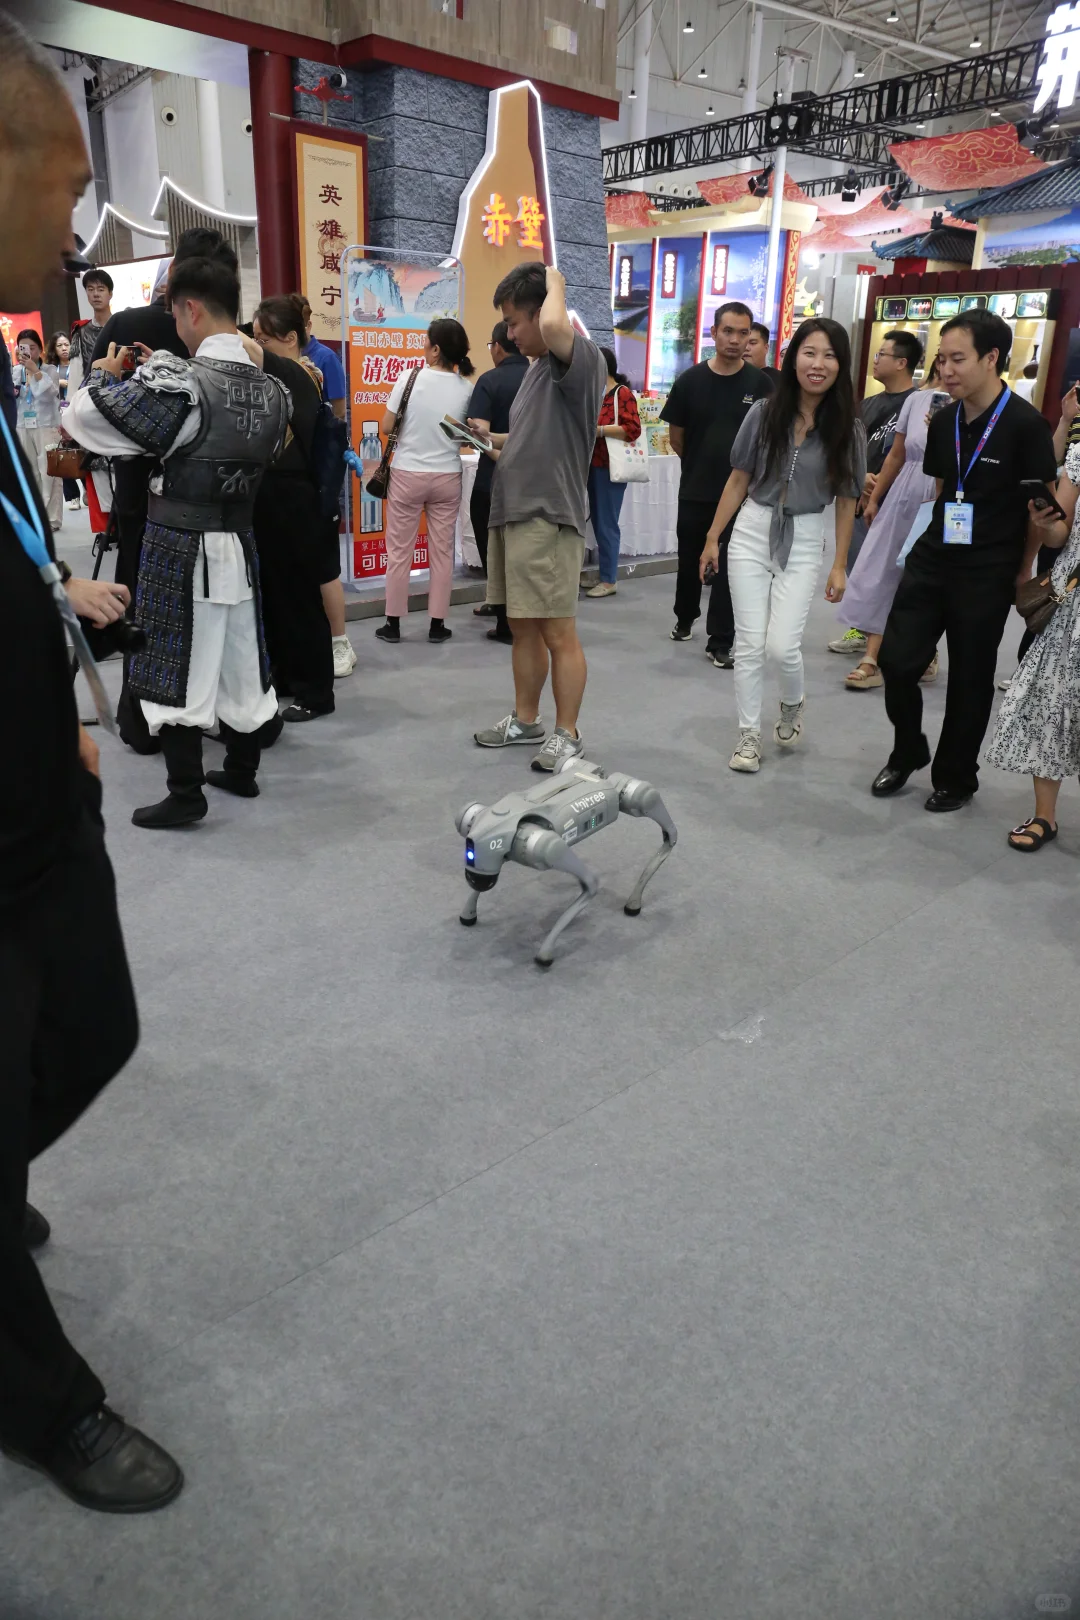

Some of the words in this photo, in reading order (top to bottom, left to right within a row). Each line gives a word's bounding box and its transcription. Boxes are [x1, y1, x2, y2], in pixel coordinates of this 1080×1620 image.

[482, 193, 545, 249] 赤壁
[318, 183, 343, 307] 英雄咸宁
[352, 331, 403, 349] 三国赤壁
[355, 391, 391, 405] 得东风之
[570, 791, 606, 813] Unitree
[489, 838, 503, 850] 02
